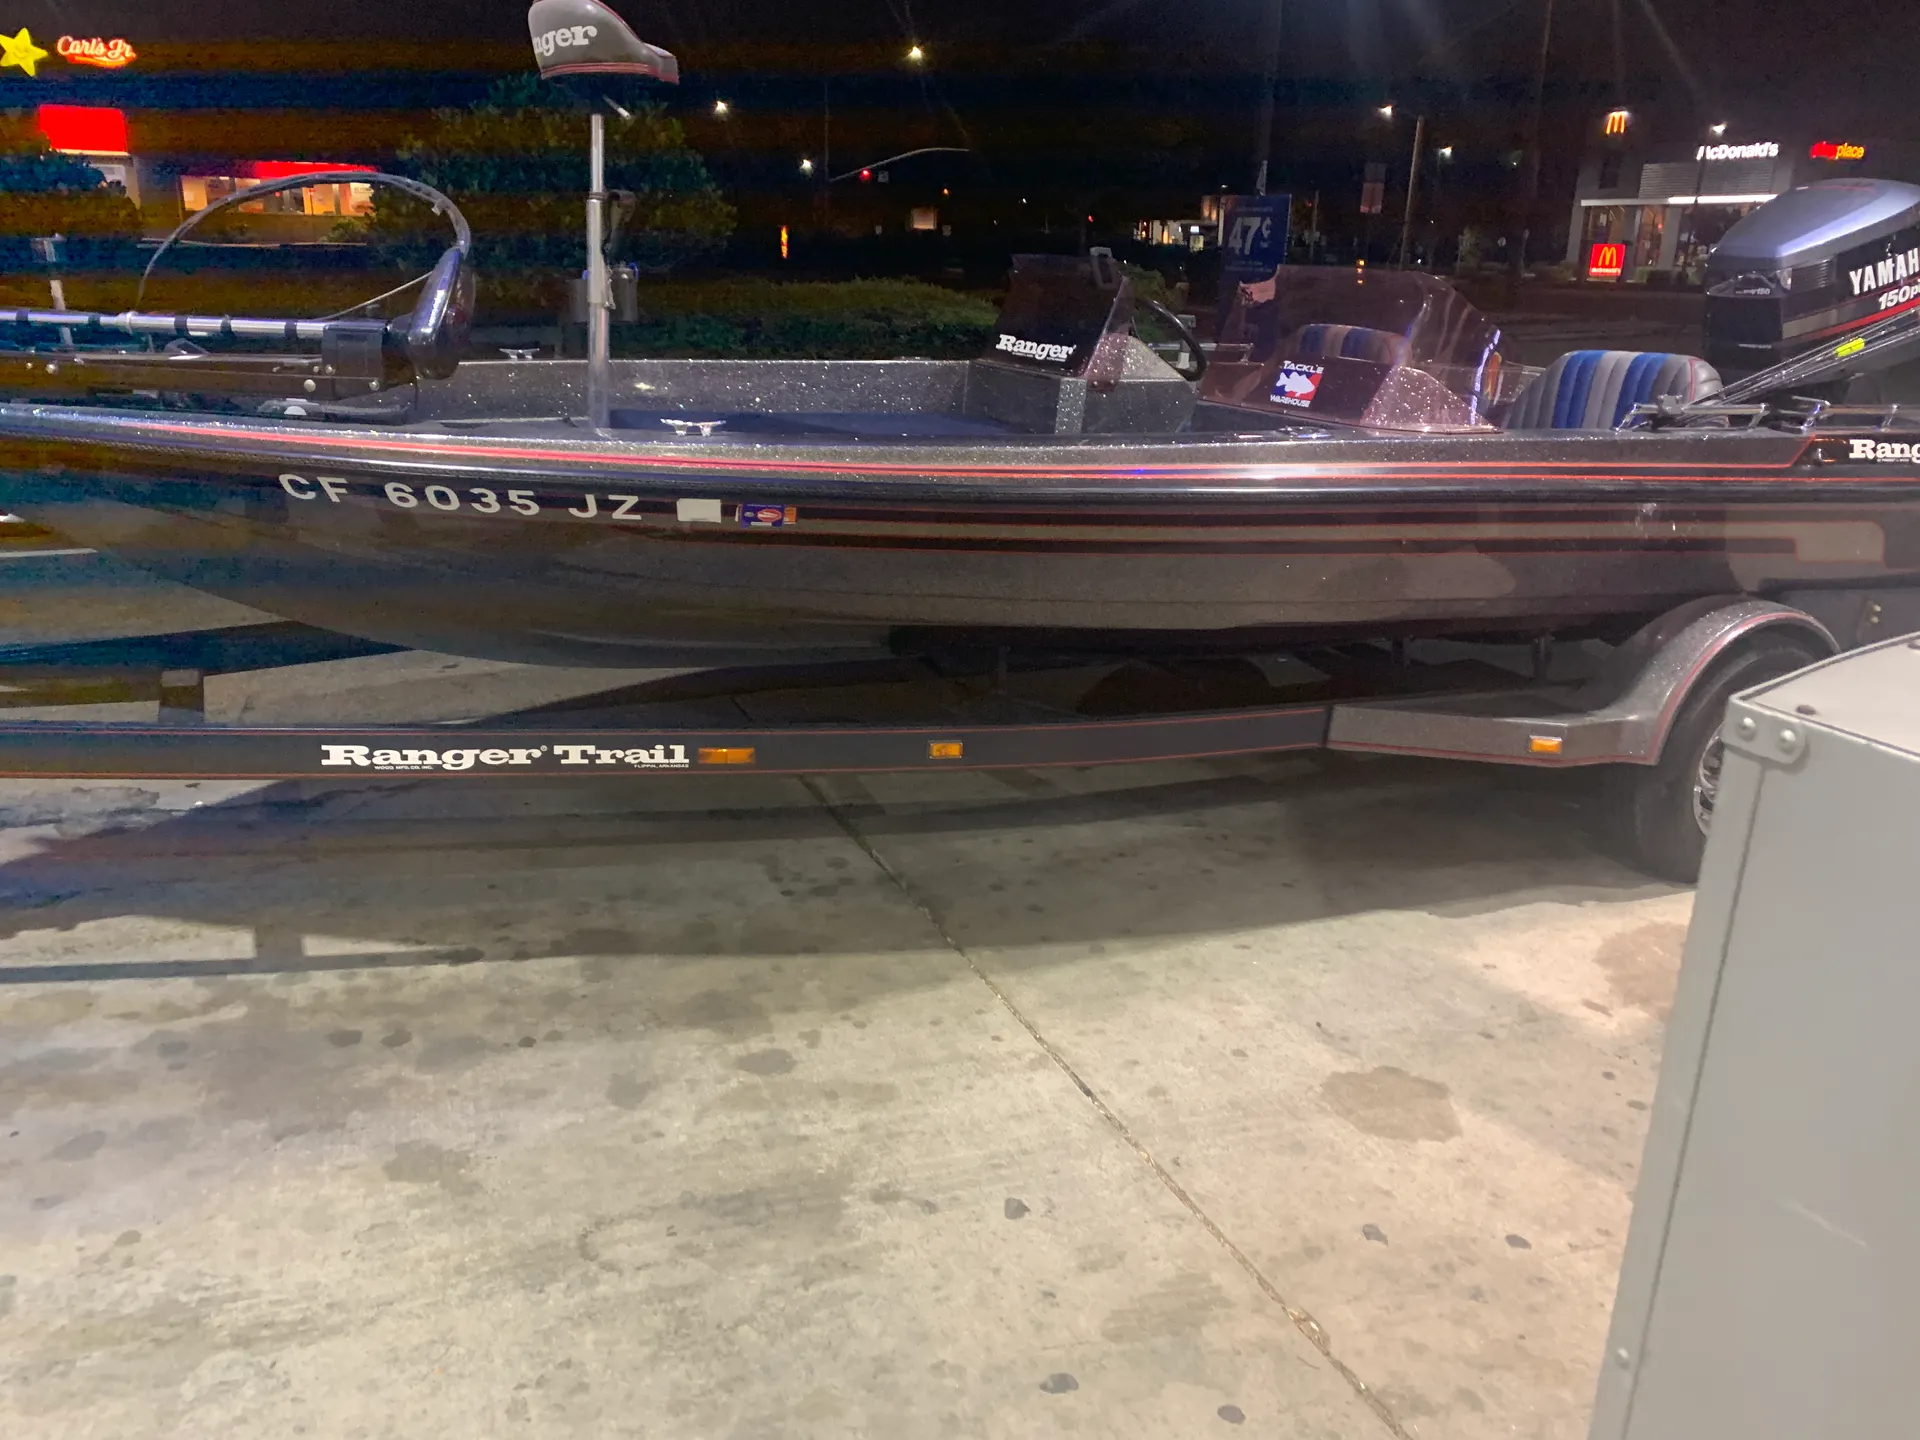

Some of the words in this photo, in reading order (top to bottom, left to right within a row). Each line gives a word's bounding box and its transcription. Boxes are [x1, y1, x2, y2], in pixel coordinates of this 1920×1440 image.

[57, 35, 106, 56] Carl's
[996, 334, 1074, 360] Ranger
[1283, 360, 1324, 374] TACKLE
[1270, 394, 1311, 408] WAREHOUSE
[279, 473, 349, 503] CF
[384, 482, 540, 516] 6035
[568, 493, 643, 521] JZ
[321, 744, 542, 771] Ranger
[553, 744, 690, 764] Trail
